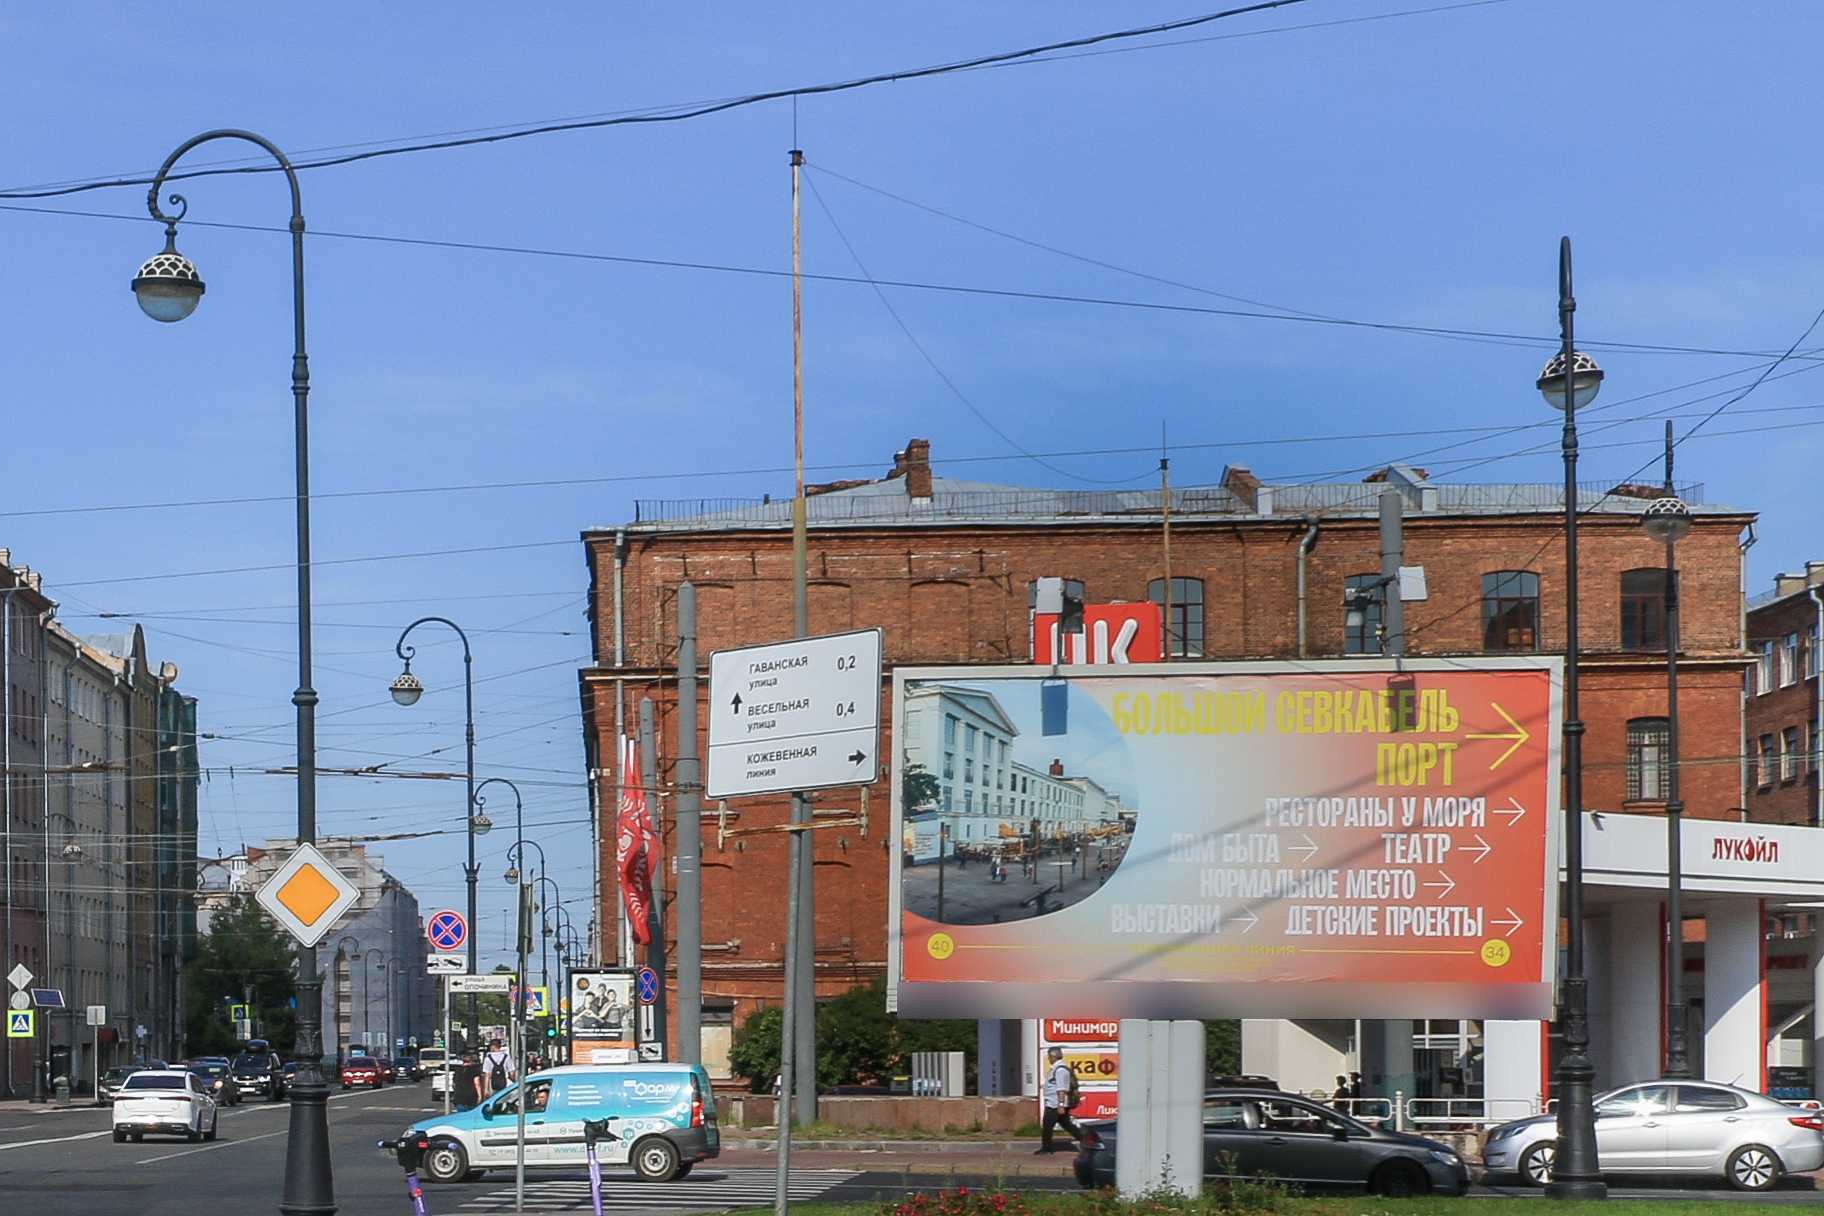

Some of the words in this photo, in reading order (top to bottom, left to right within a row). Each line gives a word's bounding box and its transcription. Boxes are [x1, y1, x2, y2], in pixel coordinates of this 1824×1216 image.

[749, 656, 808, 674] ГАВАНСКАЯ
[837, 655, 856, 672] 0,2
[749, 677, 778, 691] улица
[747, 698, 810, 717] ВЕСЕЛЬНАЯ
[836, 702, 856, 718] 0,4
[1278, 688, 1460, 736] СЕВКАБЕЛЬ
[747, 719, 776, 733] улица
[746, 746, 818, 765] КОЖЕВЕННАЯ
[1377, 743, 1458, 786] ПОРТ
[746, 767, 777, 780] линия
[1265, 796, 1394, 827] РЕСТОРАНЫ
[1400, 797, 1417, 827] У
[1423, 797, 1486, 828] МОРЯ
[1223, 832, 1281, 864] БЫТА
[1381, 833, 1452, 864] ТЕАТР
[1712, 835, 1778, 863] ЛУКОЙЛ
[1200, 868, 1338, 899] НОРМАЛЬНОЕ
[1344, 869, 1416, 900] МЕСТО
[1111, 903, 1222, 934] ВЫСТАВКИ
[1285, 905, 1378, 936] ДЕТСКИЕ
[1384, 906, 1484, 937] ПРОЕКТЫ
[931, 939, 950, 953] 40
[1485, 946, 1505, 960] 34
[1052, 1020, 1118, 1038] Минимар
[1070, 1059, 1116, 1076] каф
